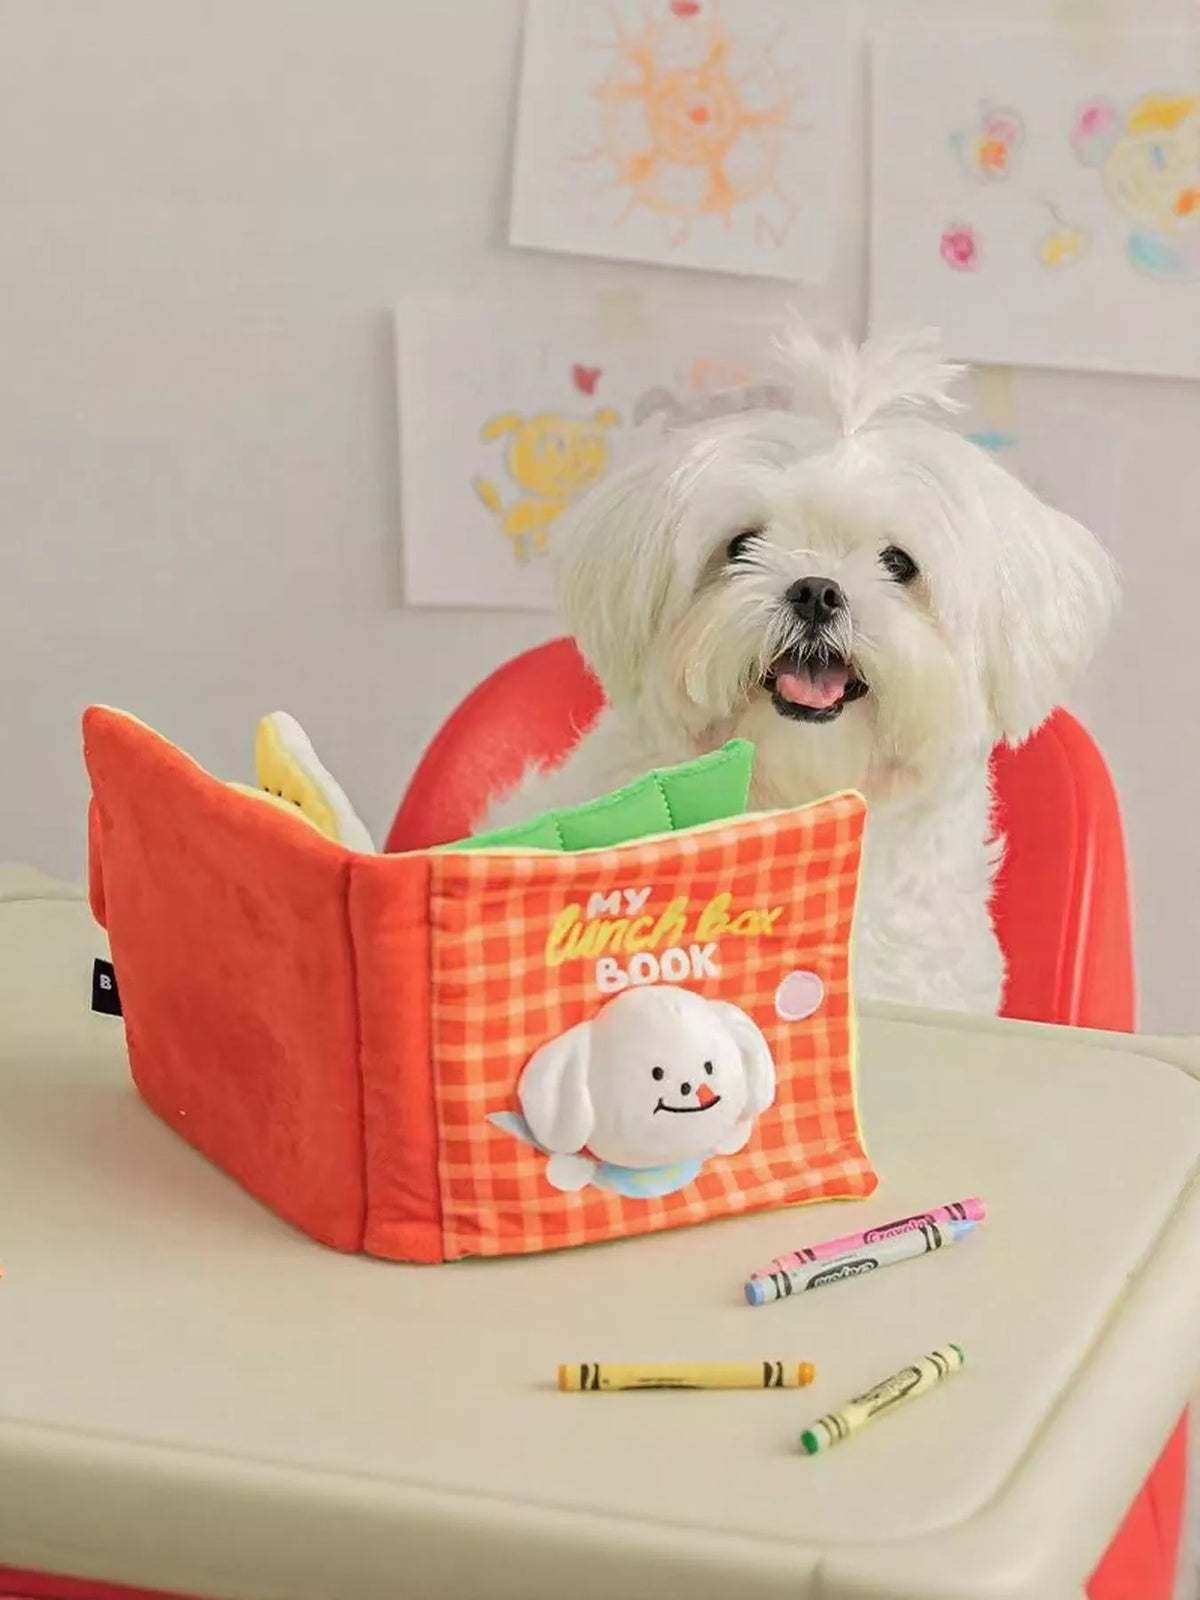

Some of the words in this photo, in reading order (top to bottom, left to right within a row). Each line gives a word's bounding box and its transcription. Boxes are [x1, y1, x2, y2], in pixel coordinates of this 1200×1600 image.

[587, 886, 652, 918] MY
[545, 896, 688, 966] lunch
[694, 892, 783, 942] box
[100, 973, 112, 990] B
[595, 942, 721, 993] BOOK
